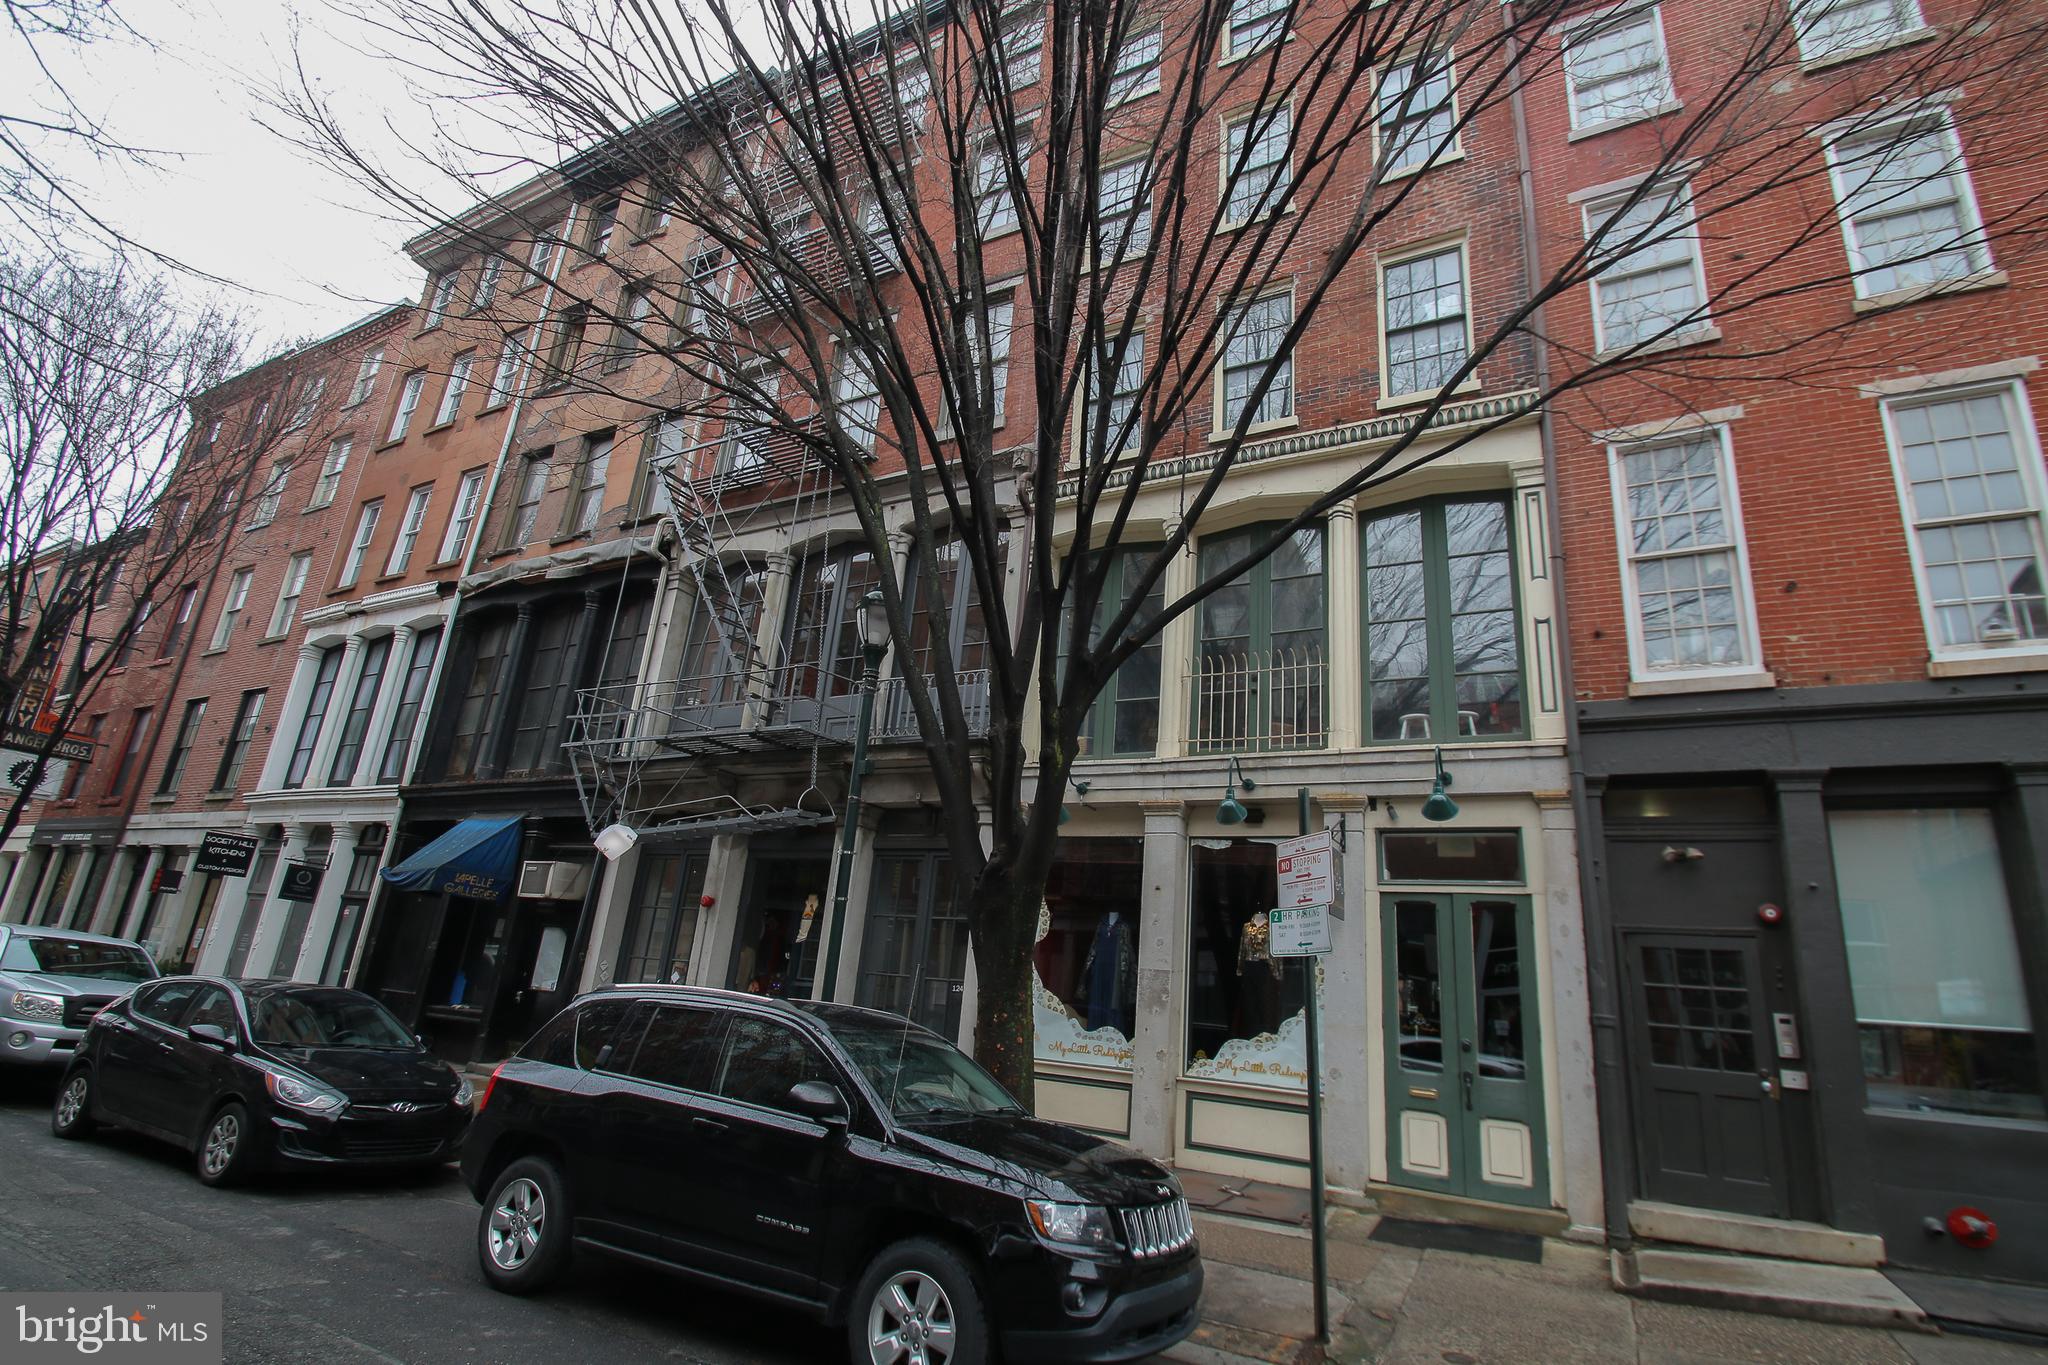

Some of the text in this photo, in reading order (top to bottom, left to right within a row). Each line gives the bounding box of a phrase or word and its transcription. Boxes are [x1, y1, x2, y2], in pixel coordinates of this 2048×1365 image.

[18, 592, 77, 728] MHINERY
[205, 835, 237, 845] SOCIETY
[208, 846, 246, 858] KITCHENS
[197, 863, 220, 871] CUSTOM
[1281, 854, 1321, 871] NO STOPPING
[1274, 908, 1320, 921] 2 HR PARKING
[756, 1214, 810, 1234] COMPASS
